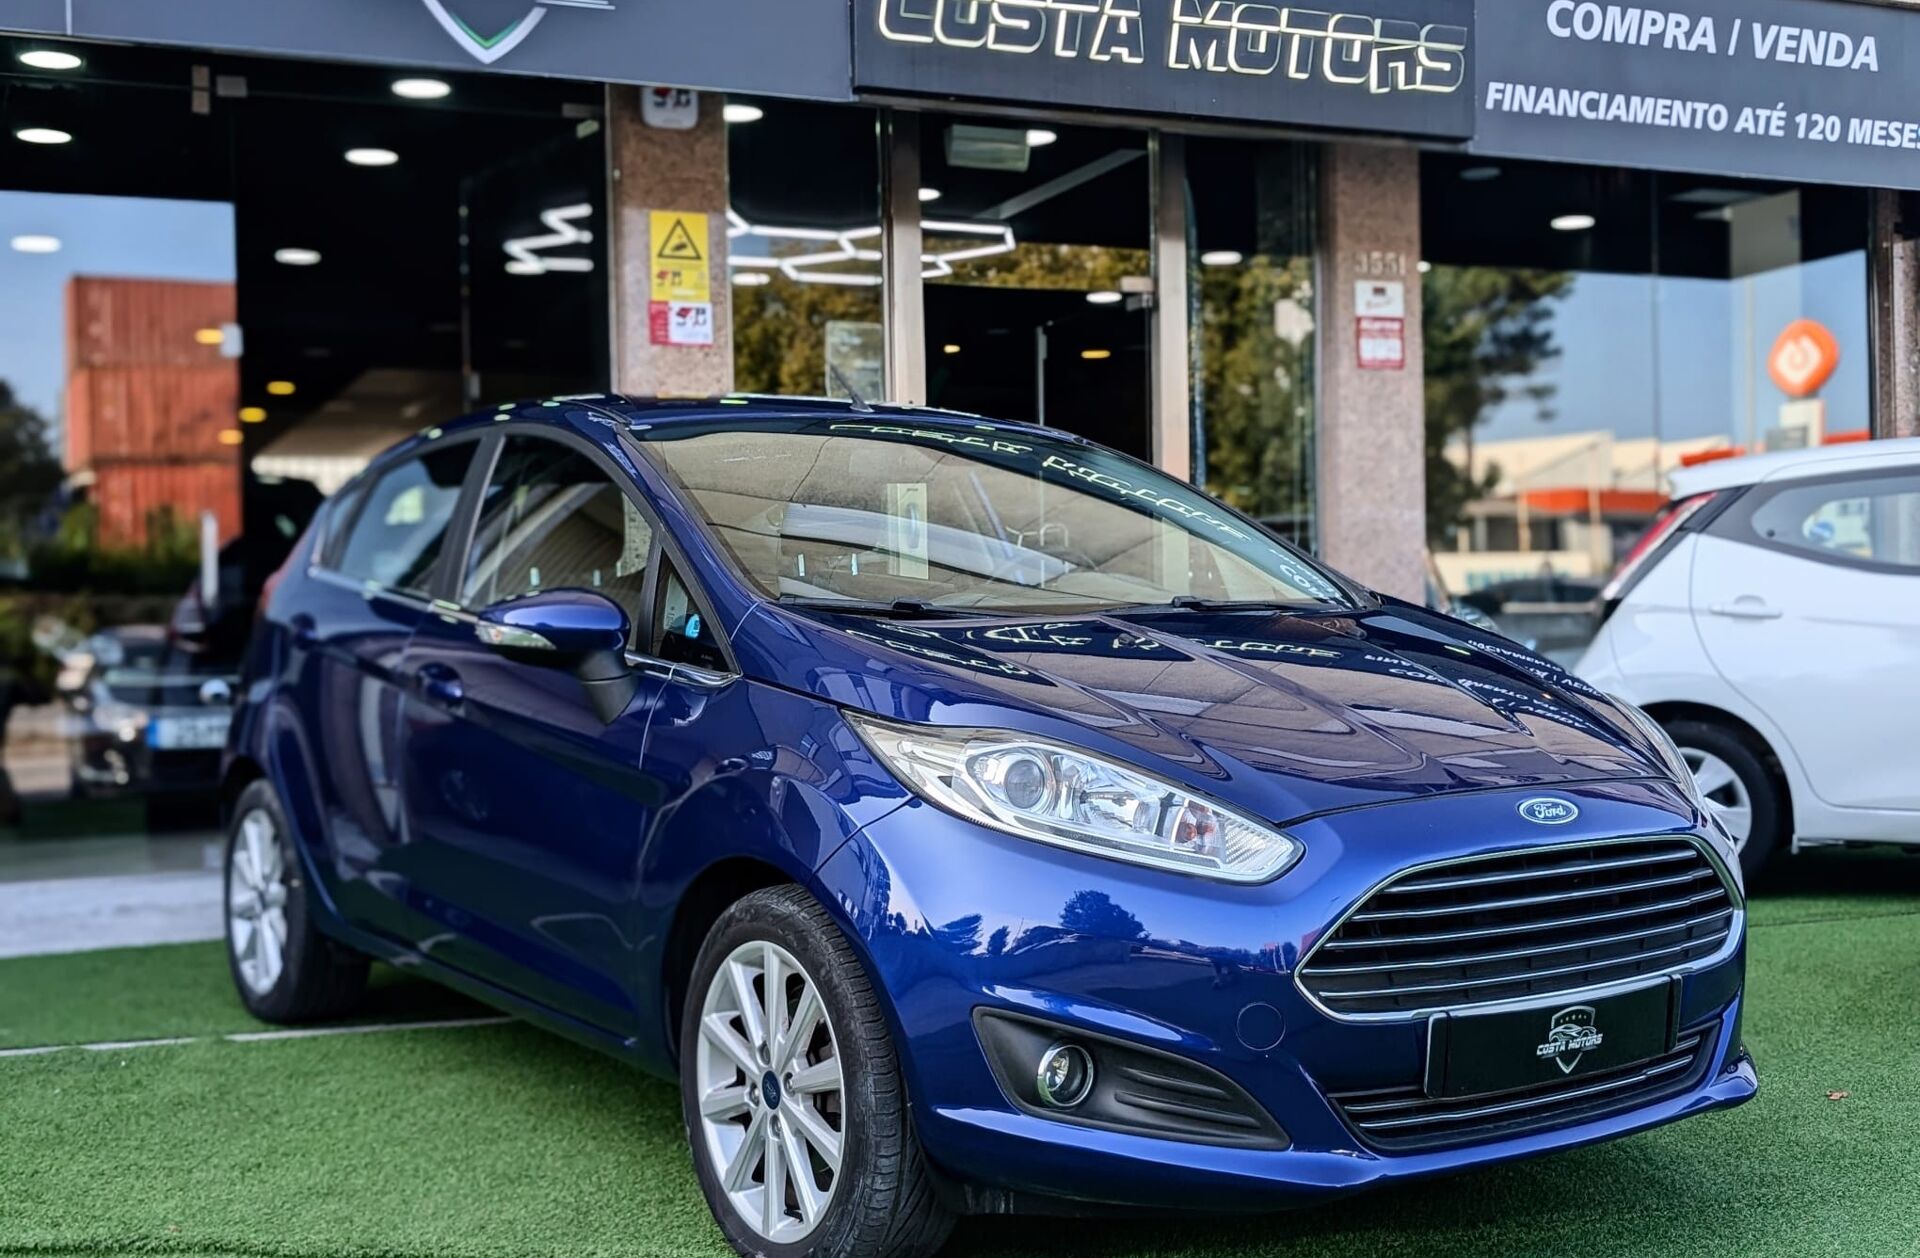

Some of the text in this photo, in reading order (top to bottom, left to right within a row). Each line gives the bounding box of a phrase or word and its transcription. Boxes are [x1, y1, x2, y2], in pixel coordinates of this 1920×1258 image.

[878, 0, 1468, 93] COSTA MOTORS
[1546, 0, 1879, 72] COMPRA / VENDA
[1485, 82, 1729, 131] FINANCIAMENTO
[1734, 102, 1787, 137] ATÉ
[1794, 113, 1841, 142] 120
[1533, 803, 1566, 818] Ford
[1536, 1033, 1603, 1056] COSTA MOTORS
